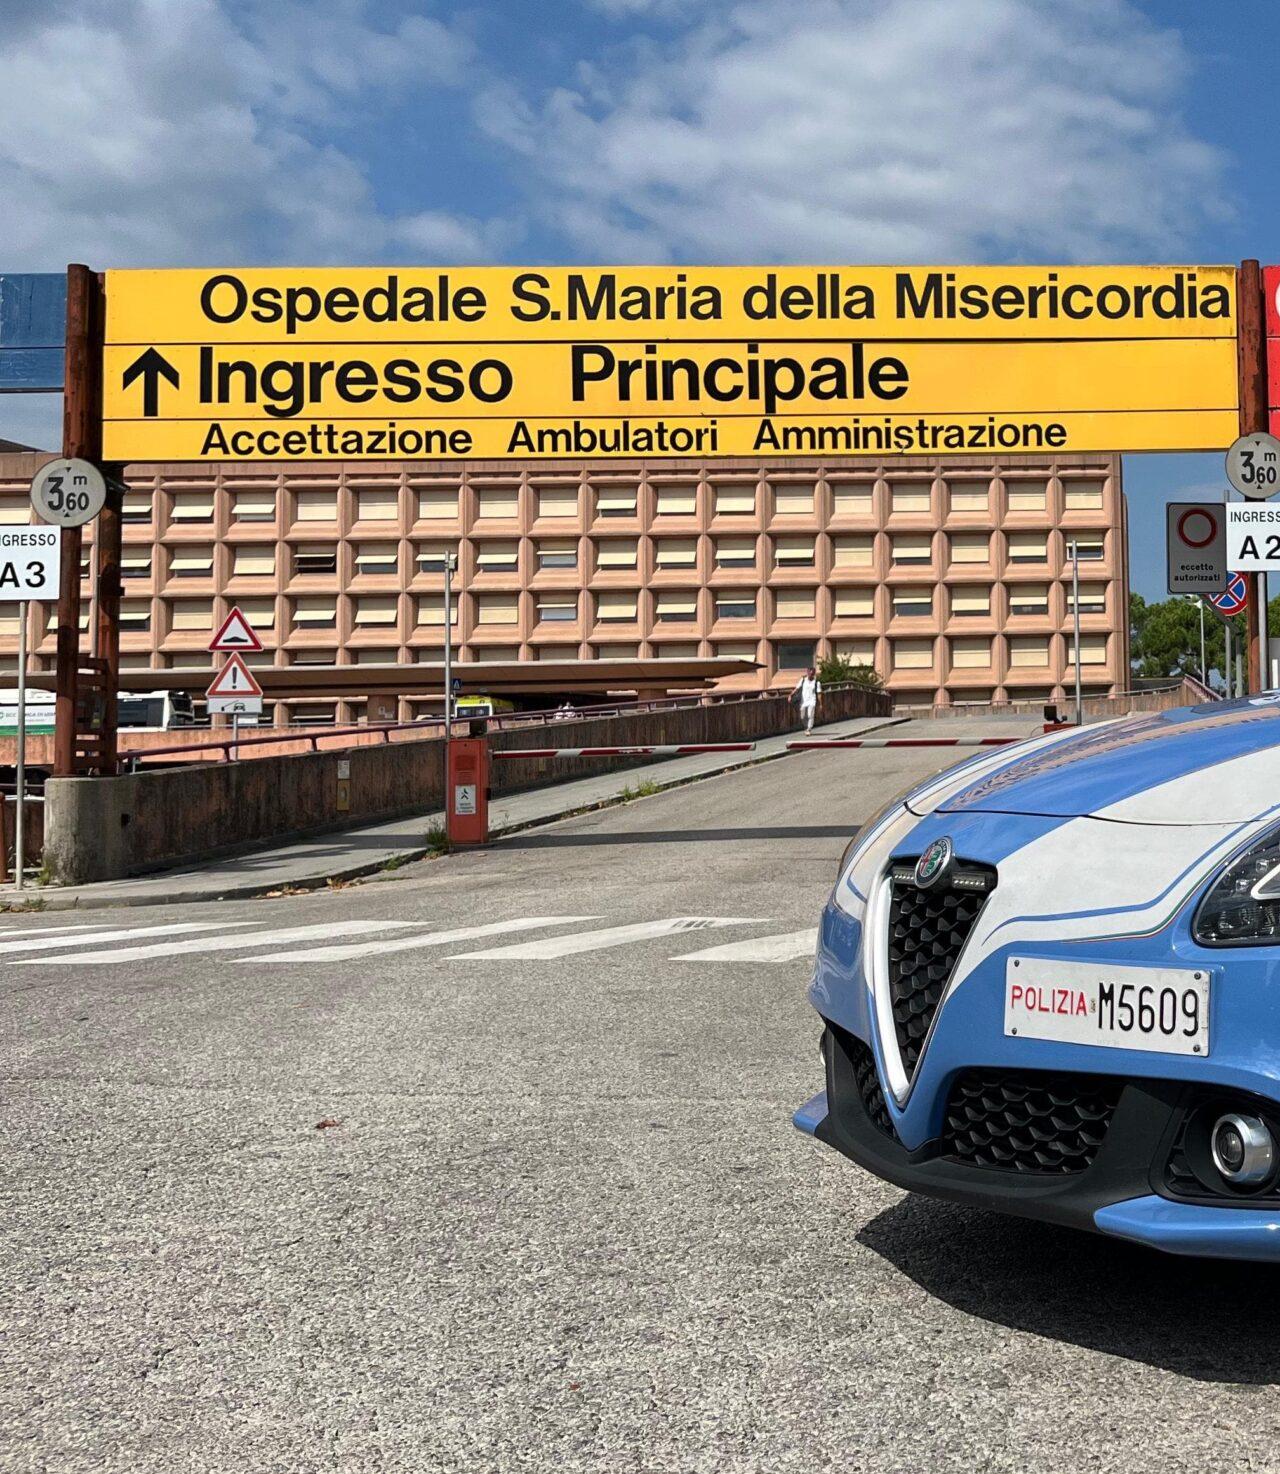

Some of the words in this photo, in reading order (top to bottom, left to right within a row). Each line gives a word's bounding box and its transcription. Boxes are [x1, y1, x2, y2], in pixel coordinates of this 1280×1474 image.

[200, 274, 487, 335] Ospedale
[510, 273, 722, 322] S.Maria
[742, 273, 876, 321] della
[895, 273, 1231, 320] Misericordia
[199, 346, 513, 418] Ingresso
[571, 342, 910, 414] Principale
[200, 421, 473, 456] Accettazione
[506, 419, 718, 453] Ambulatori
[752, 416, 1067, 452] Amministrazione
[1264, 452, 1277, 462] m
[73, 475, 88, 486] m
[0, 533, 57, 547] GRESSO
[1180, 563, 1214, 571] eccetto
[1174, 572, 1221, 582] autorizzati
[1011, 984, 1088, 1016] POLIZIA
[1098, 982, 1200, 1037] M5609
